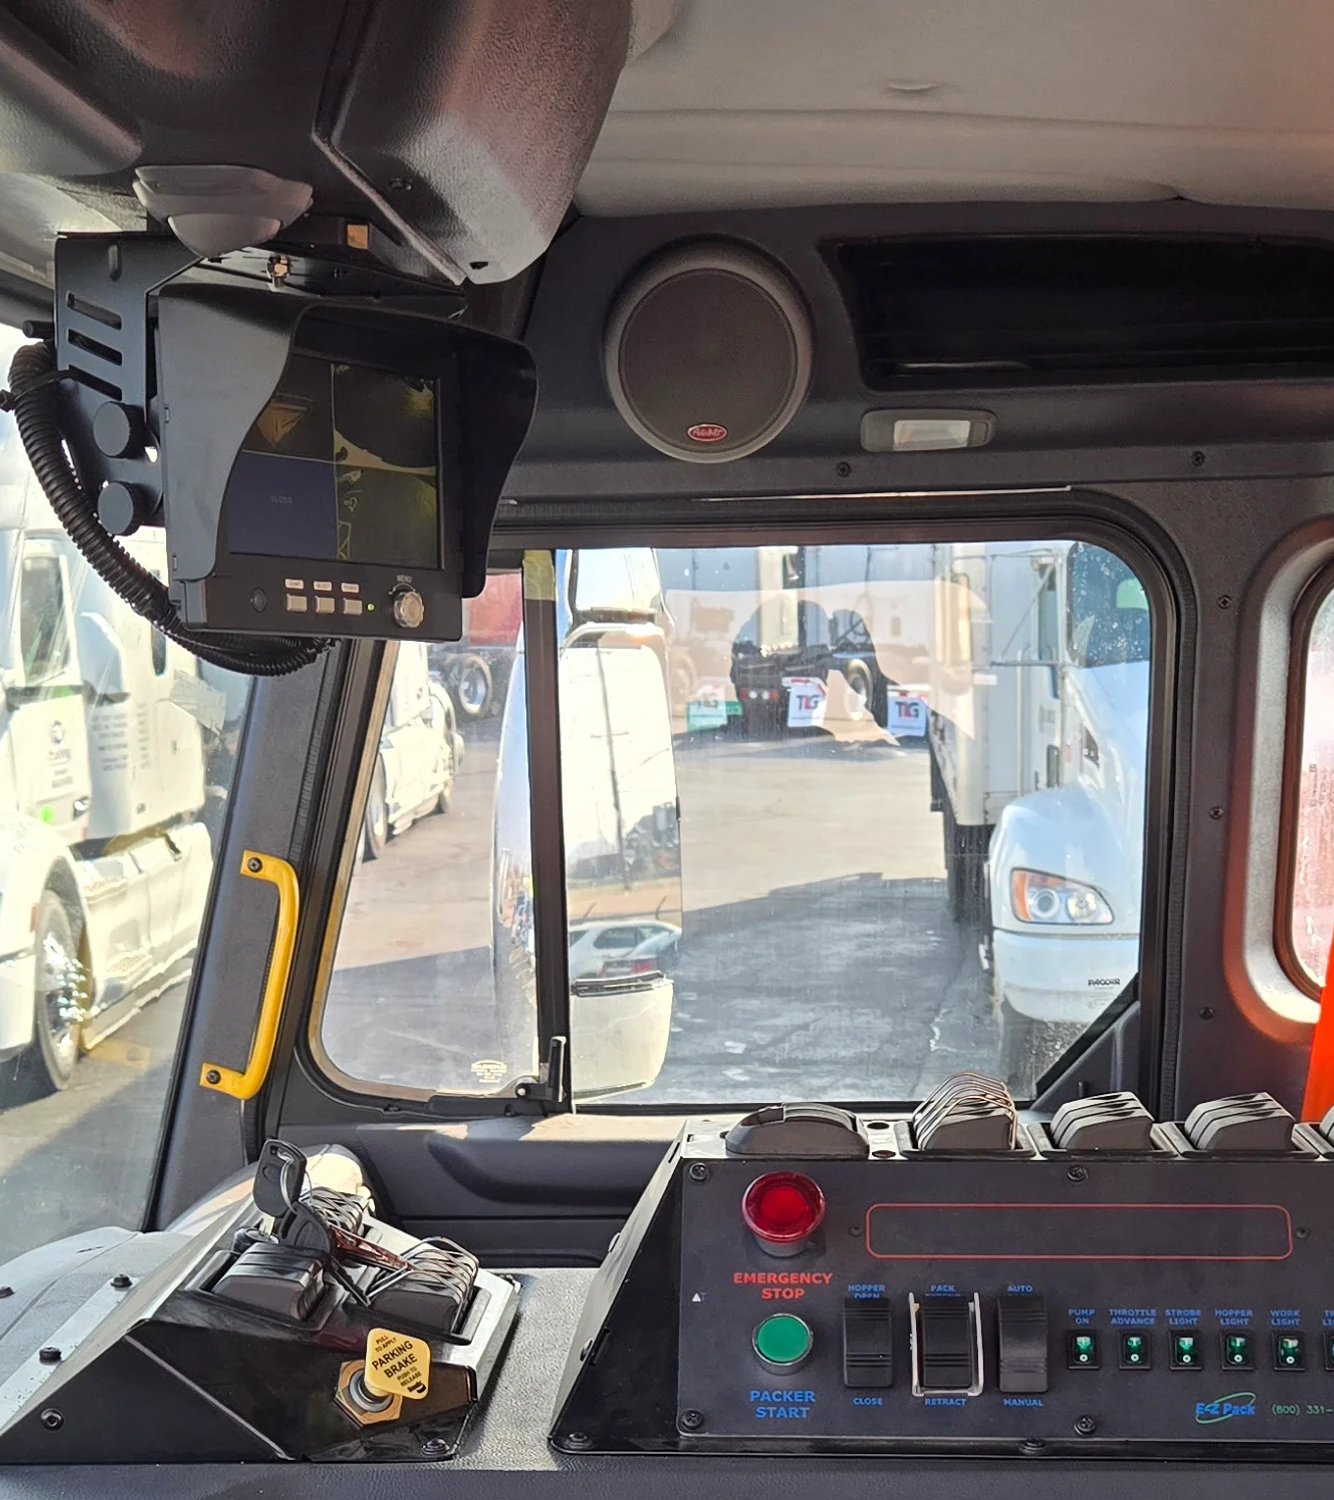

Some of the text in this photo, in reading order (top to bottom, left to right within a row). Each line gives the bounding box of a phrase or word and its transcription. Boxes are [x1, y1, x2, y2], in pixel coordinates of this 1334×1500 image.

[895, 702, 919, 719] TLG
[733, 1272, 833, 1285] EMERGENCY
[847, 1284, 886, 1293] HOPPER
[931, 1285, 956, 1293] PACK
[1007, 1285, 1033, 1293] AUTO
[761, 1287, 806, 1300] STOP
[1068, 1309, 1095, 1317] PUMP
[1109, 1309, 1157, 1317] THROTTLE
[1165, 1309, 1201, 1317] STROBE
[1215, 1309, 1253, 1318] HOPPER
[1075, 1317, 1090, 1325] ON
[1111, 1317, 1156, 1326] ADVANCE
[1169, 1318, 1198, 1326] LIGHT
[1220, 1318, 1249, 1326] LIGHT
[1271, 1318, 1301, 1326] LIGHT
[372, 1340, 413, 1370] PARKING
[384, 1353, 418, 1379] BRAKE
[749, 1390, 816, 1403] PACKER
[852, 1397, 883, 1406] CLOSE
[925, 1398, 967, 1407] RETRACT
[1004, 1398, 1044, 1407] MANUAL
[755, 1406, 811, 1419] START
[1223, 1402, 1256, 1416] Pack
[1271, 1404, 1301, 1416] (800)
